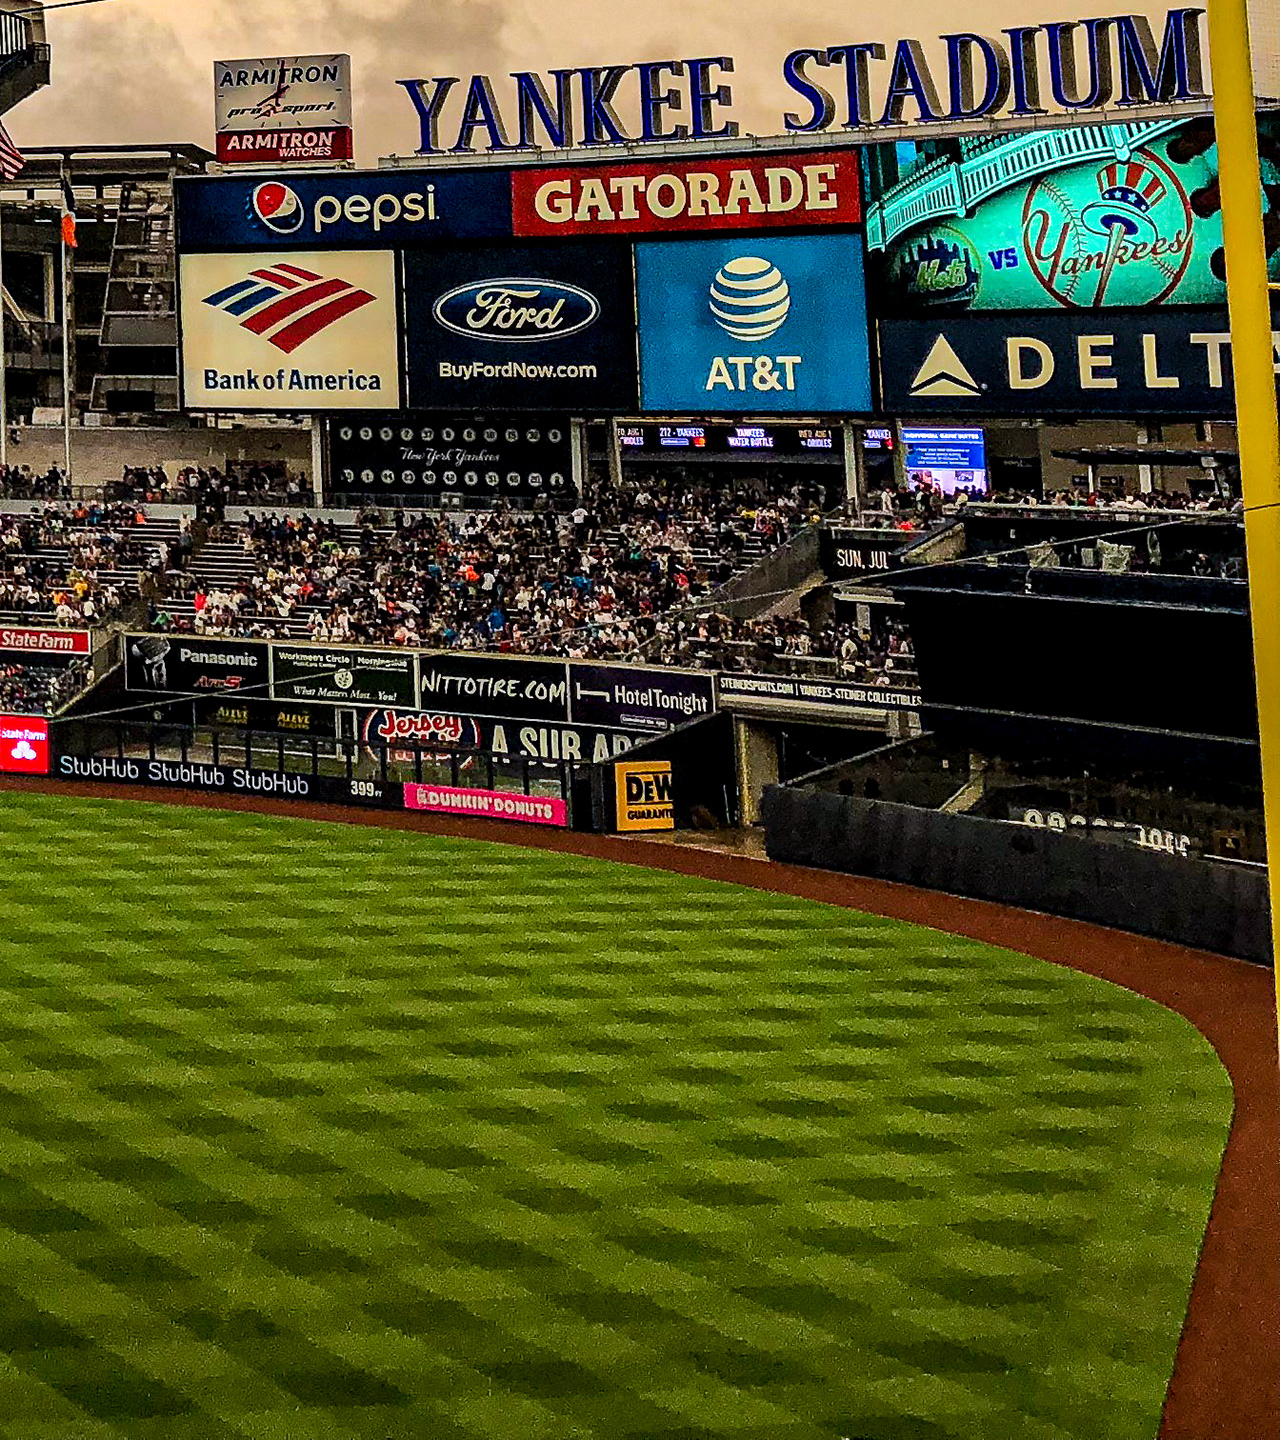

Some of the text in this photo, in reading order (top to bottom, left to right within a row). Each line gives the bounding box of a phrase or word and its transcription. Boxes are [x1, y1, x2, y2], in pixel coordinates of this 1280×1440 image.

[220, 65, 337, 87] ARMITRON
[396, 7, 1205, 156] YANKEE STADIUM
[227, 101, 335, 118] pro sport
[227, 132, 334, 150] ARMITRON
[279, 146, 332, 157] WATCHES
[314, 184, 436, 233] pepsi
[535, 164, 838, 223] GATORADE
[1023, 210, 1189, 290] Yankees
[916, 258, 967, 291] Mets
[467, 286, 567, 333] Ford
[439, 362, 598, 380] BuyFordNow.com
[706, 356, 802, 391] AT&T
[1007, 333, 1280, 389] DELT
[204, 369, 381, 391] Bank of America
[180, 647, 258, 667] Panasonic
[421, 669, 566, 706] NITTOTIRE.COM
[614, 685, 708, 714] HotelTonight
[378, 710, 463, 740] Jersey
[492, 725, 508, 763] A
[60, 755, 309, 795] StubHub StubHub StubHub
[350, 780, 374, 796] 399
[429, 790, 553, 819] DUNKIN' DONUTS
